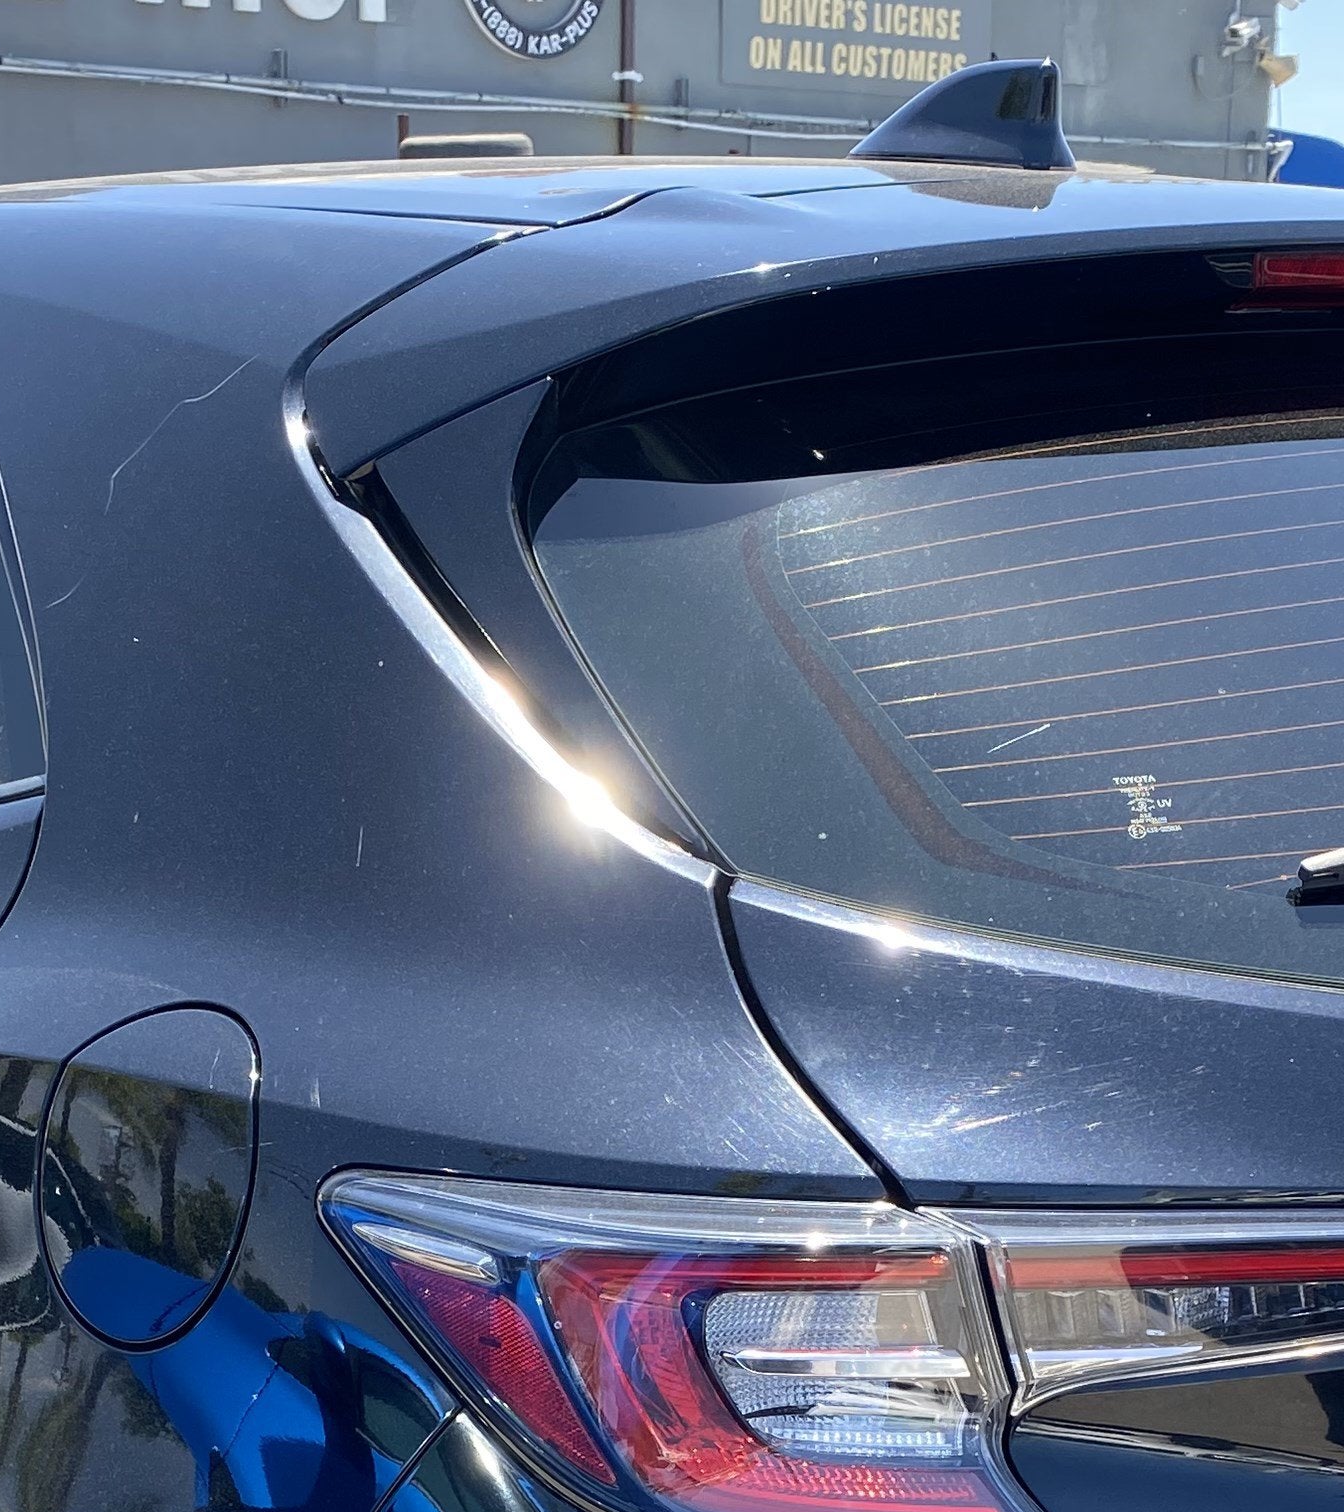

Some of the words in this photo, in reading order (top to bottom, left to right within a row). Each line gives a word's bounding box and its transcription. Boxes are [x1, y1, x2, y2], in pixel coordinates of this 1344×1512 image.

[527, 0, 599, 55] KAR-PLUS
[760, 0, 868, 33] DRIVER'S
[873, 3, 962, 41] LICENSE
[749, 36, 783, 70] ON
[787, 40, 826, 74] ALL
[831, 43, 967, 82] CUSTOMERS
[1112, 774, 1157, 785] TOYOTA
